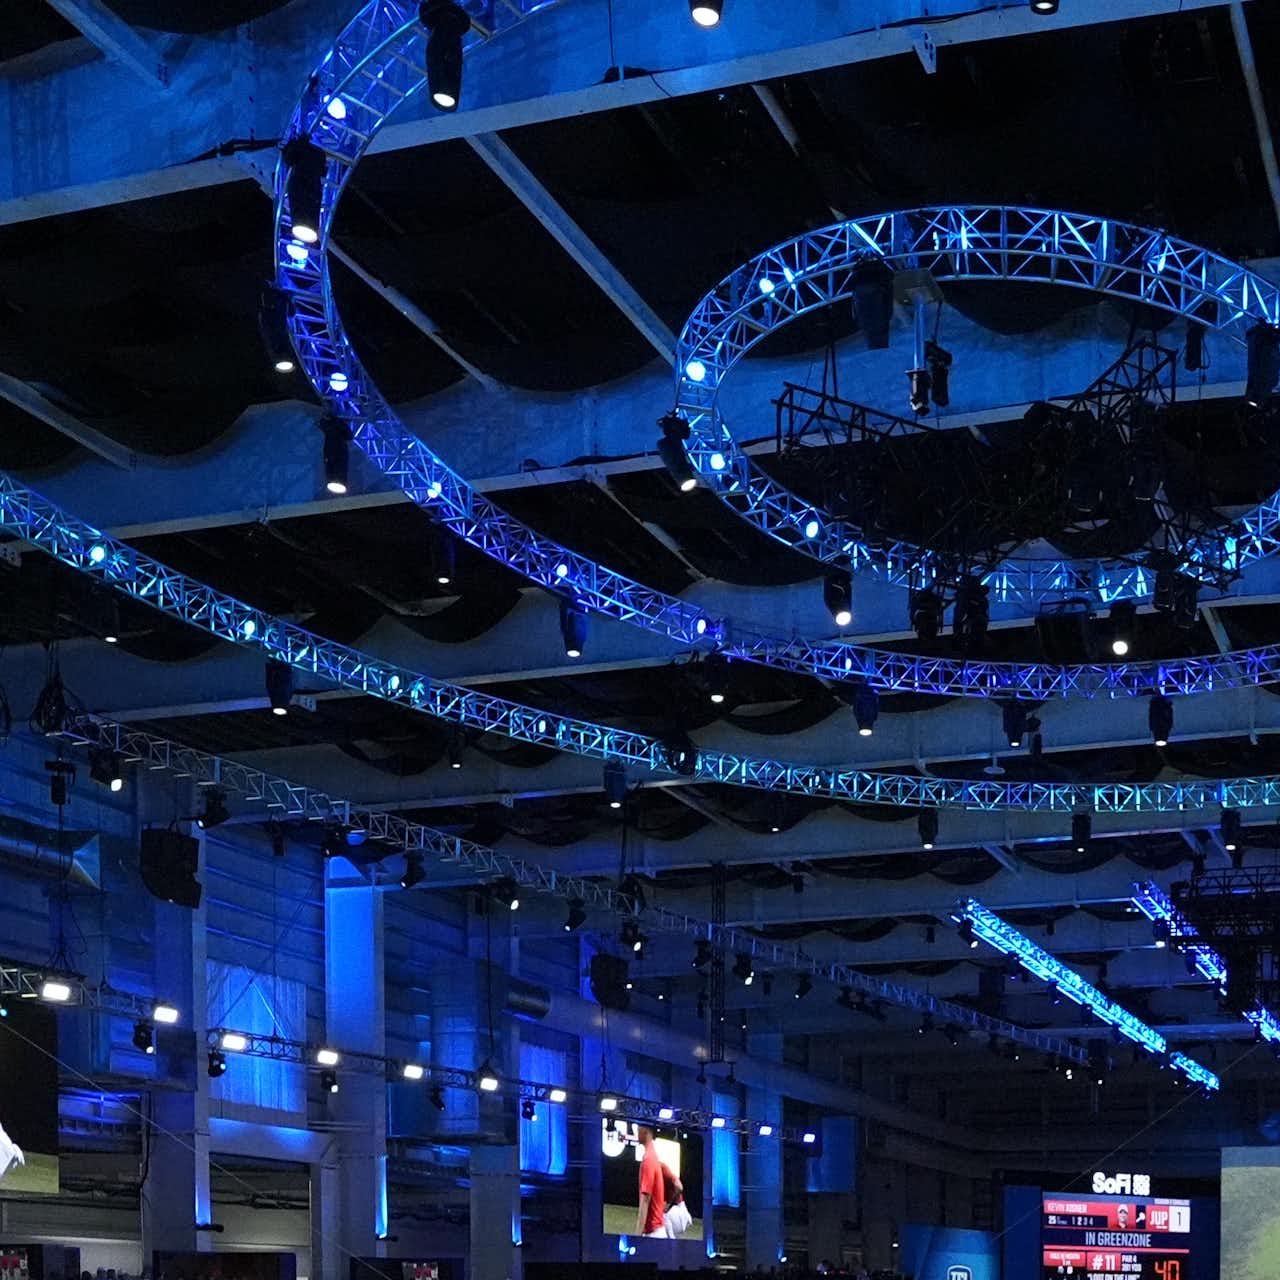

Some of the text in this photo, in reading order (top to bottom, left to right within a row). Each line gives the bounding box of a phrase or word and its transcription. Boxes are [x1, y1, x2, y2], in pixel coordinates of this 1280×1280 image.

[1092, 1172, 1131, 1195] SoFi
[1150, 1211, 1168, 1225] JUP
[1086, 1232, 1152, 1247] IN GREENZONE
